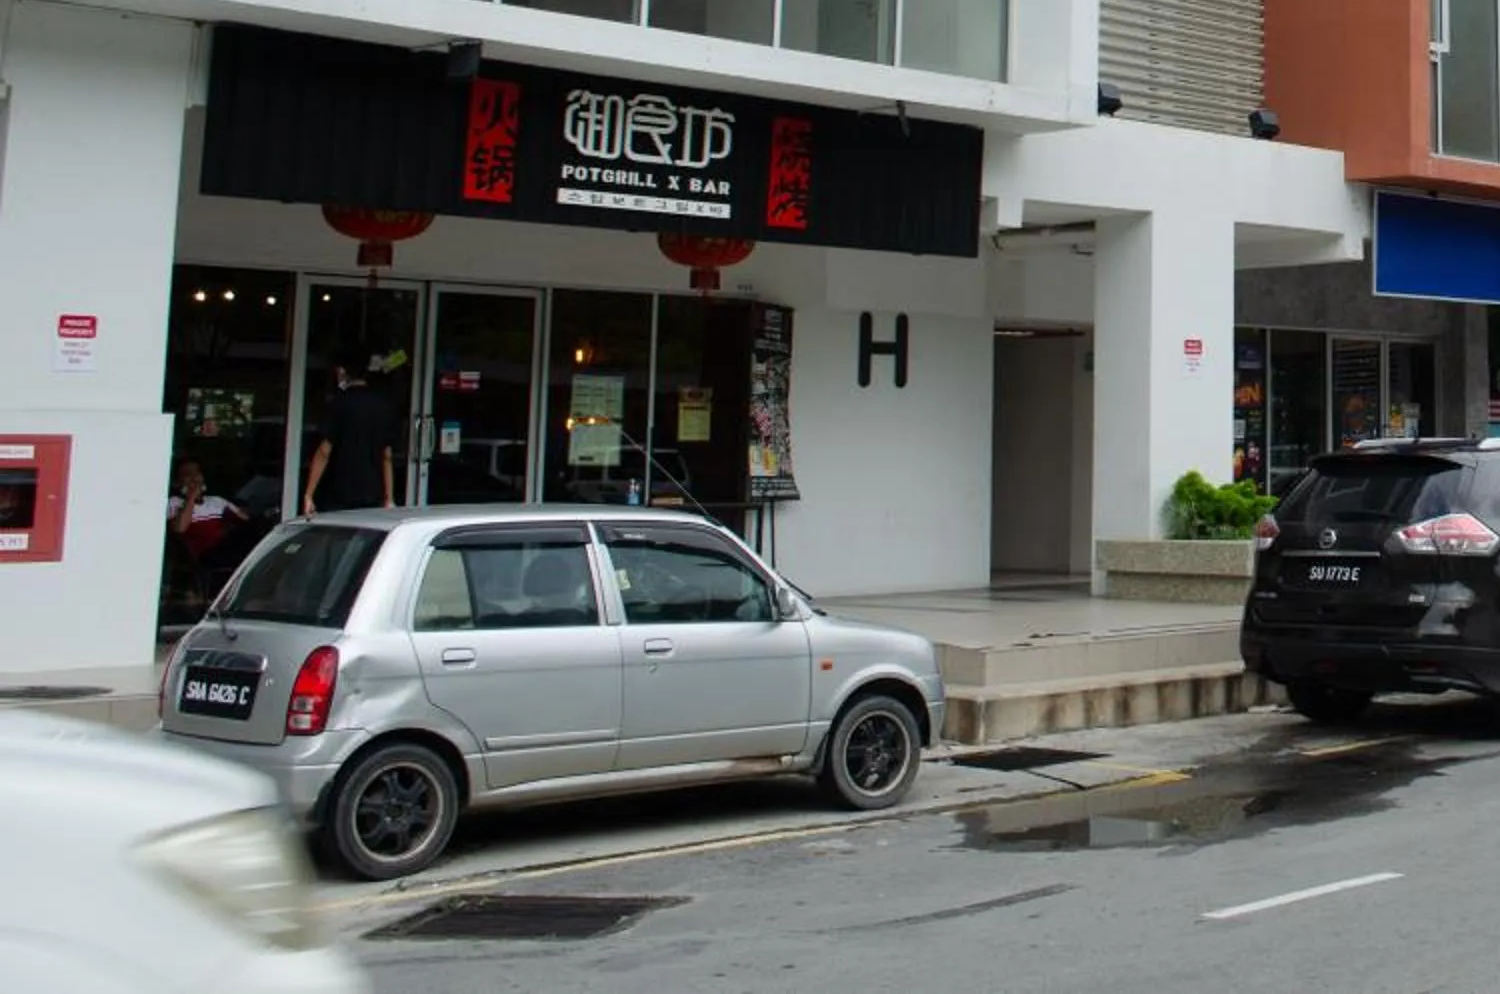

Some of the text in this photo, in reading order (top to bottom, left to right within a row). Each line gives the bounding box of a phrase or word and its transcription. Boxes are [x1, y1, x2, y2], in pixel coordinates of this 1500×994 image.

[561, 164, 731, 196] POTGRILL X BAR
[858, 311, 909, 389] H
[1309, 566, 1325, 580] SU
[1351, 567, 1360, 581] E
[239, 686, 250, 705] C
